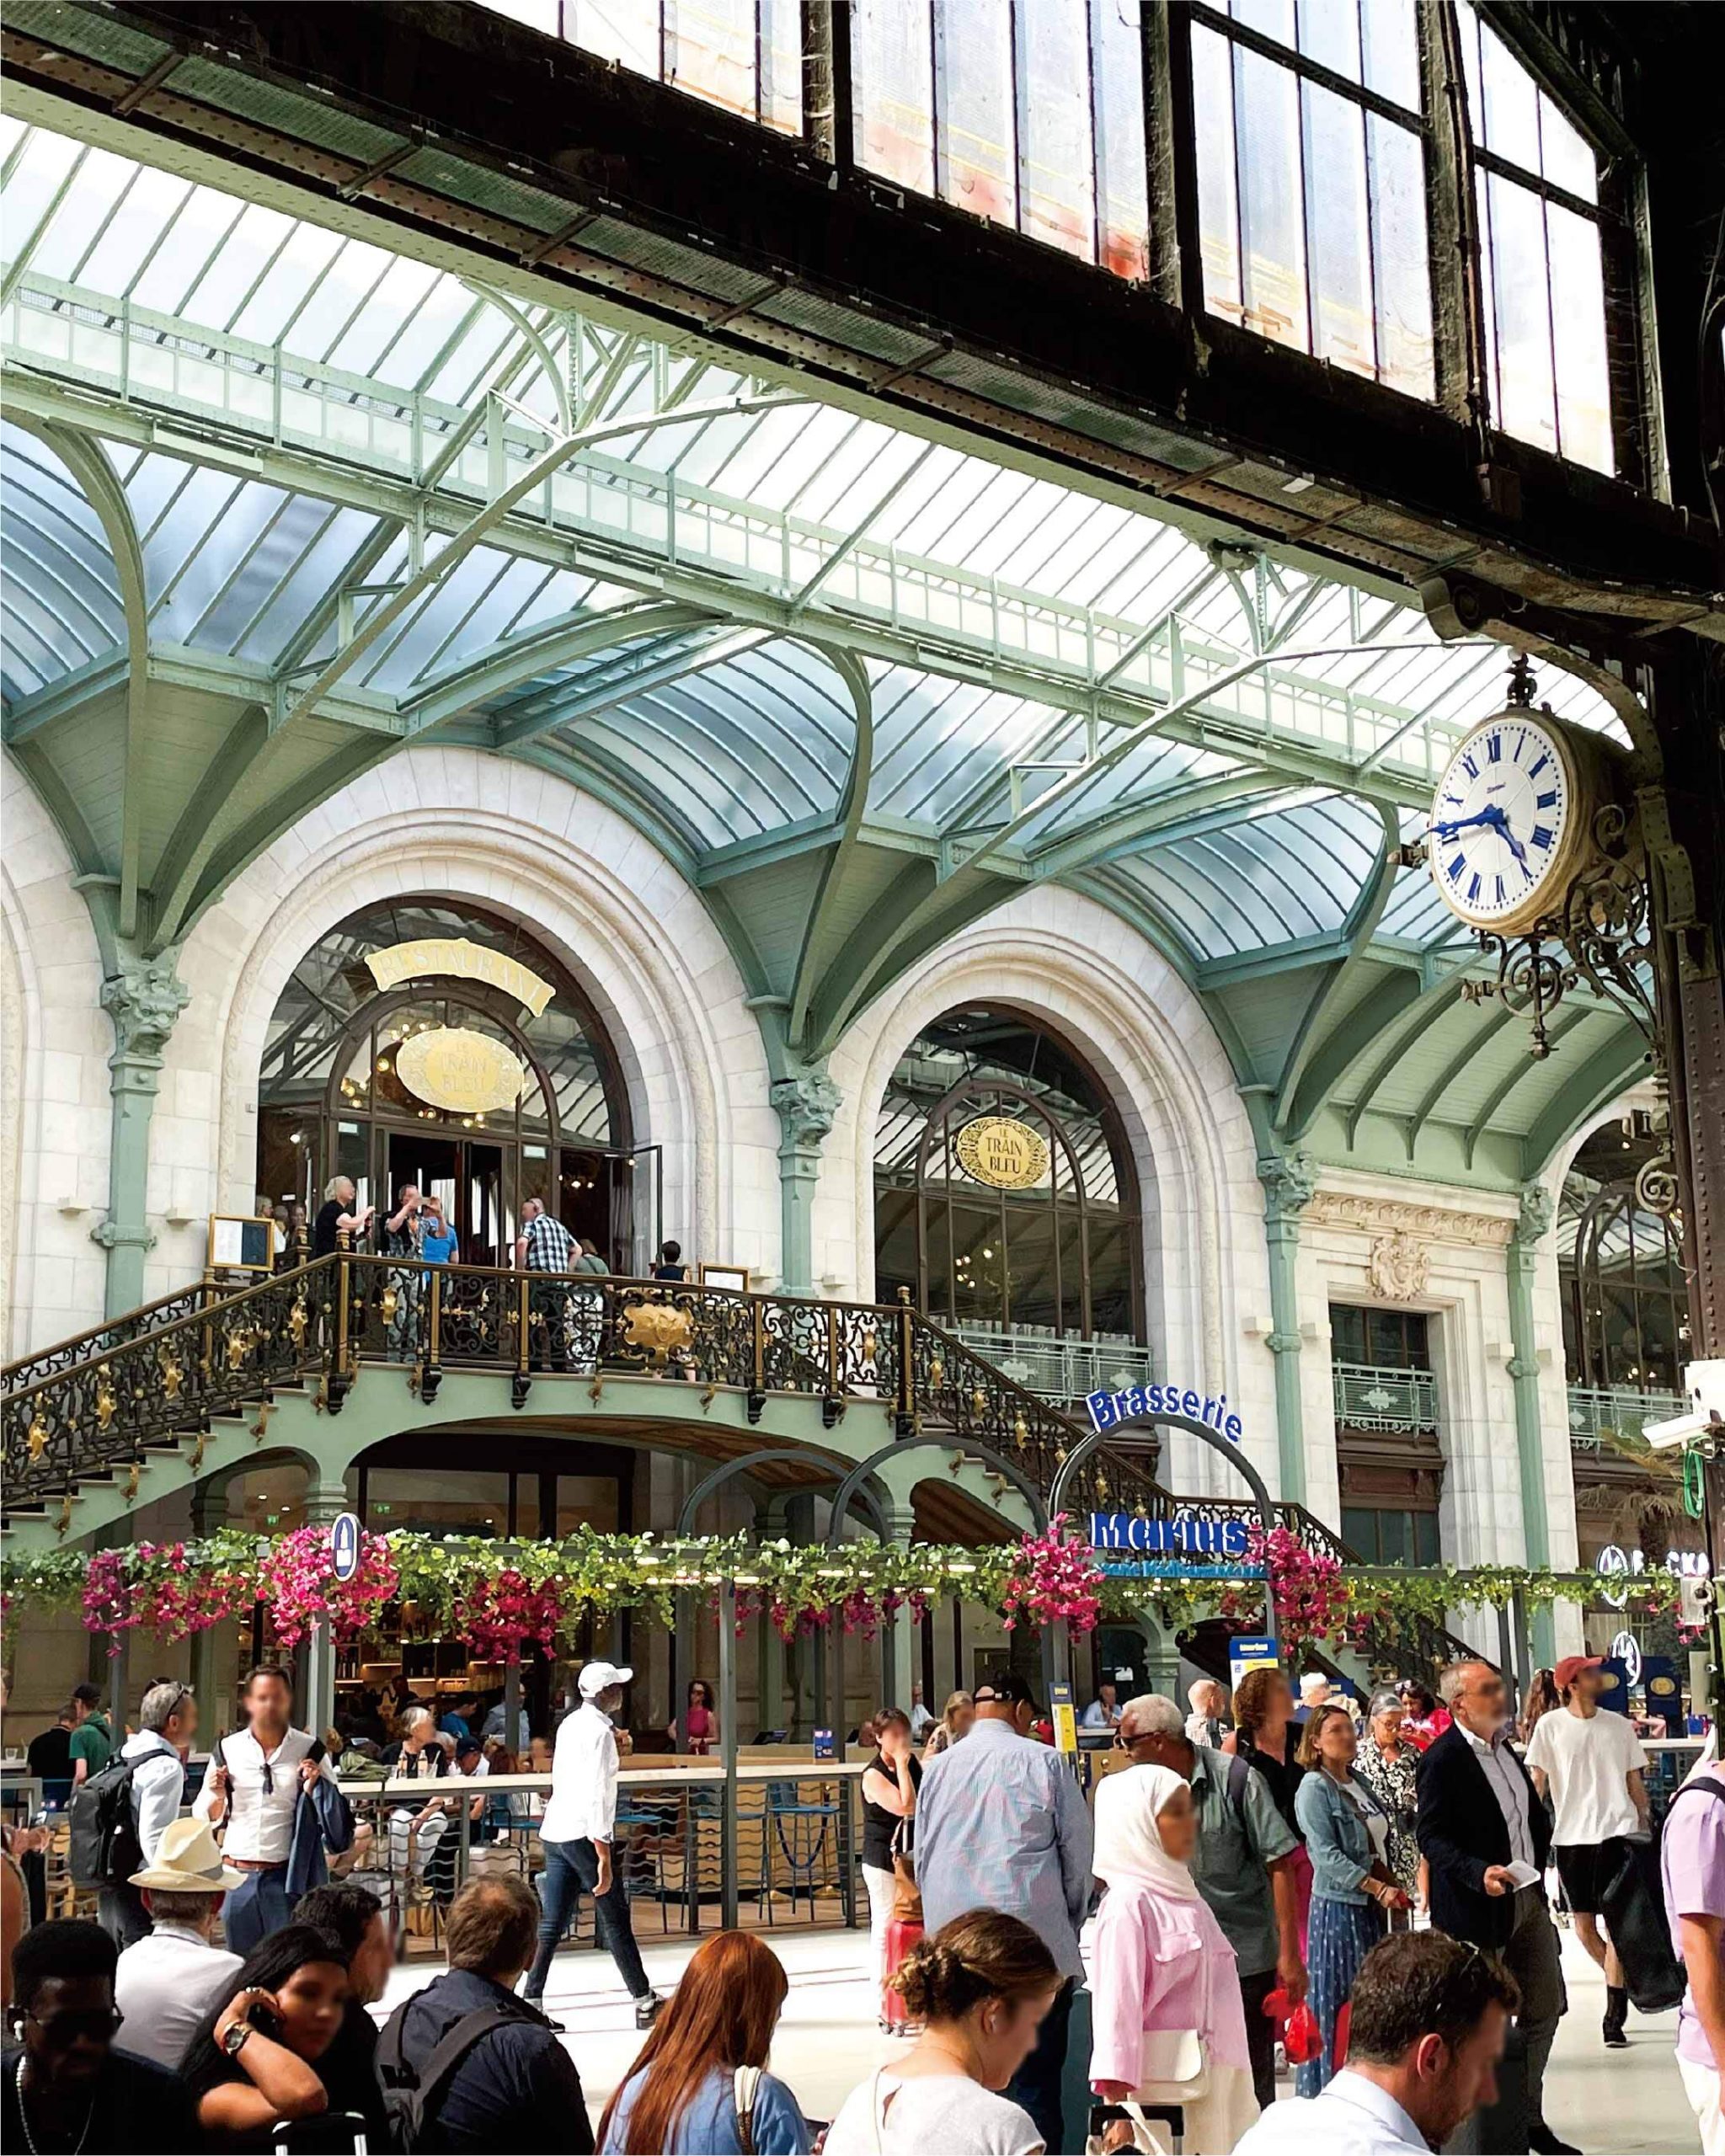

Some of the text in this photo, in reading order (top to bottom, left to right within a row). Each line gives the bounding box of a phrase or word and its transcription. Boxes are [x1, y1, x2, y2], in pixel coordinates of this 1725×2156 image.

[377, 944, 545, 1006] RESTAURANT
[441, 1053, 487, 1076] TRAIN
[441, 1074, 485, 1092] BLEU
[999, 1128, 1009, 1139] LE
[985, 1137, 1023, 1156] TRAIN
[990, 1156, 1021, 1174] BLEU
[1086, 1385, 1242, 1444] Brasserie
[1090, 1513, 1248, 1557] Marius
